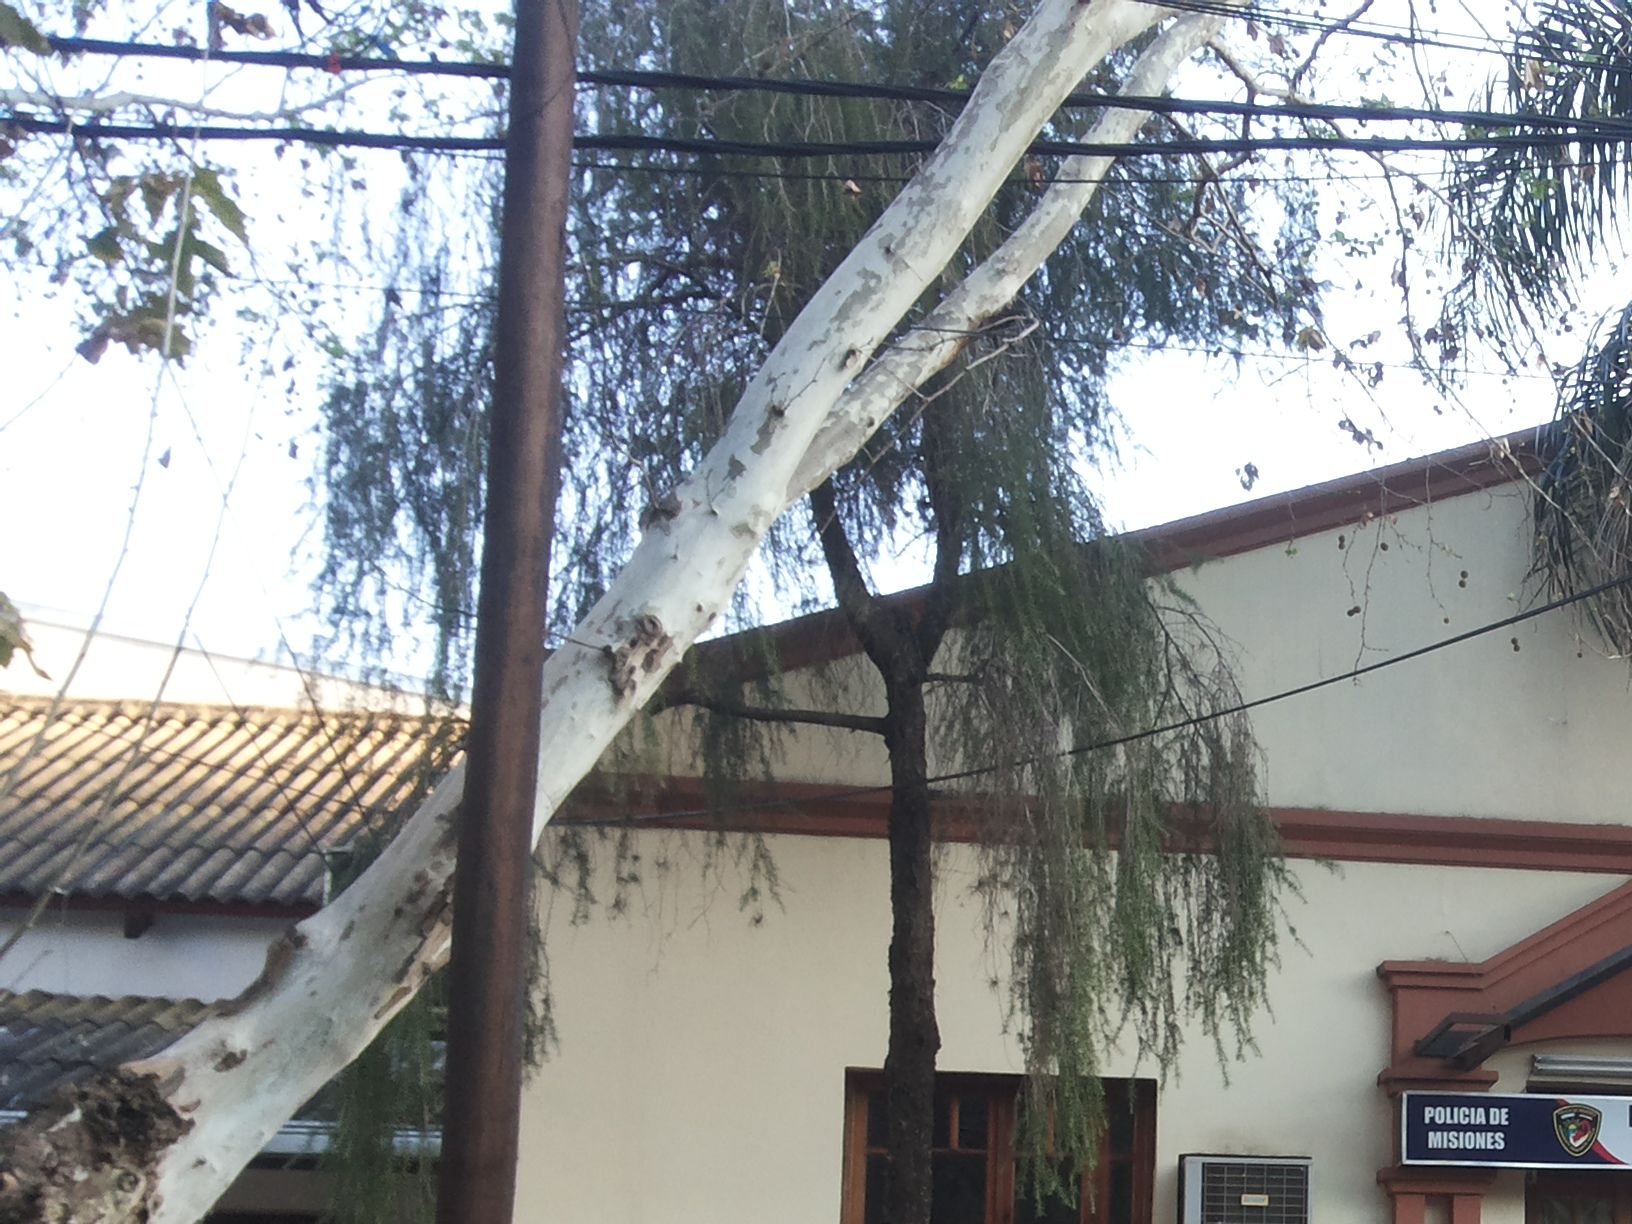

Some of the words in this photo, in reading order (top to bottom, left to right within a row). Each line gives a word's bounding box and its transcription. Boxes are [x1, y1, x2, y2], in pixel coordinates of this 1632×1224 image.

[1424, 1106, 1486, 1125] POLICIA
[1489, 1107, 1509, 1126] DE
[1427, 1131, 1505, 1150] MISIONES
